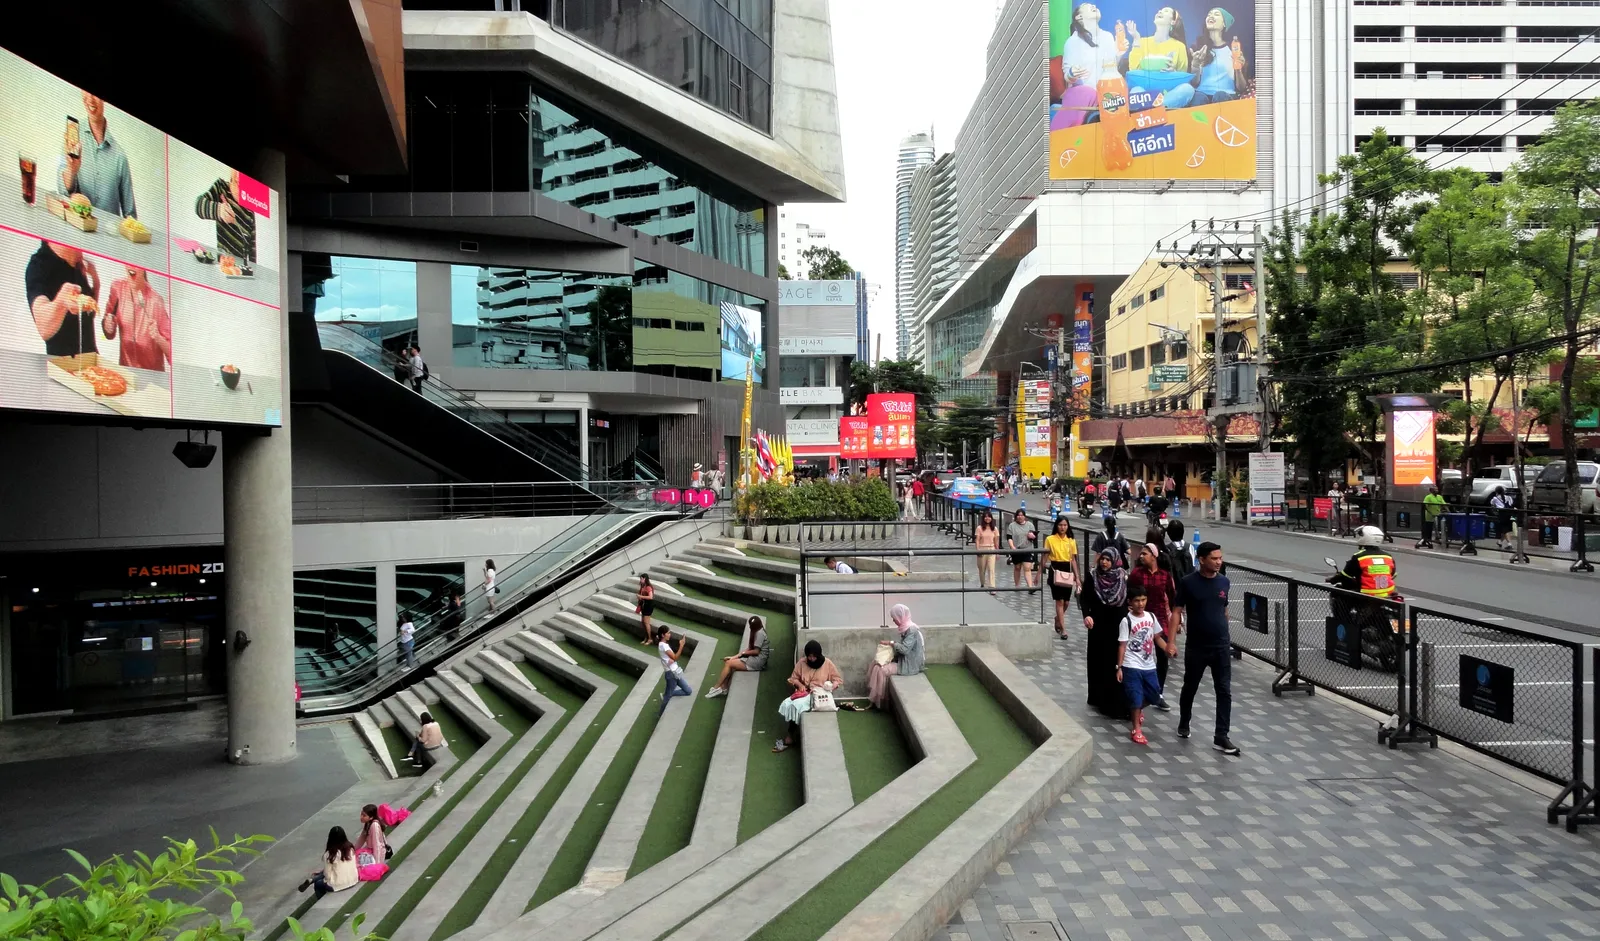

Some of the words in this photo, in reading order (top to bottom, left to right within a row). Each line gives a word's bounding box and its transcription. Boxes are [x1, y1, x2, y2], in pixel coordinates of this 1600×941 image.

[1129, 93, 1152, 107] สนุก
[1129, 134, 1173, 154] ได้อีก!
[246, 193, 268, 210] foodpanda
[800, 339, 824, 347] 마사지
[128, 564, 201, 577] FASHION
